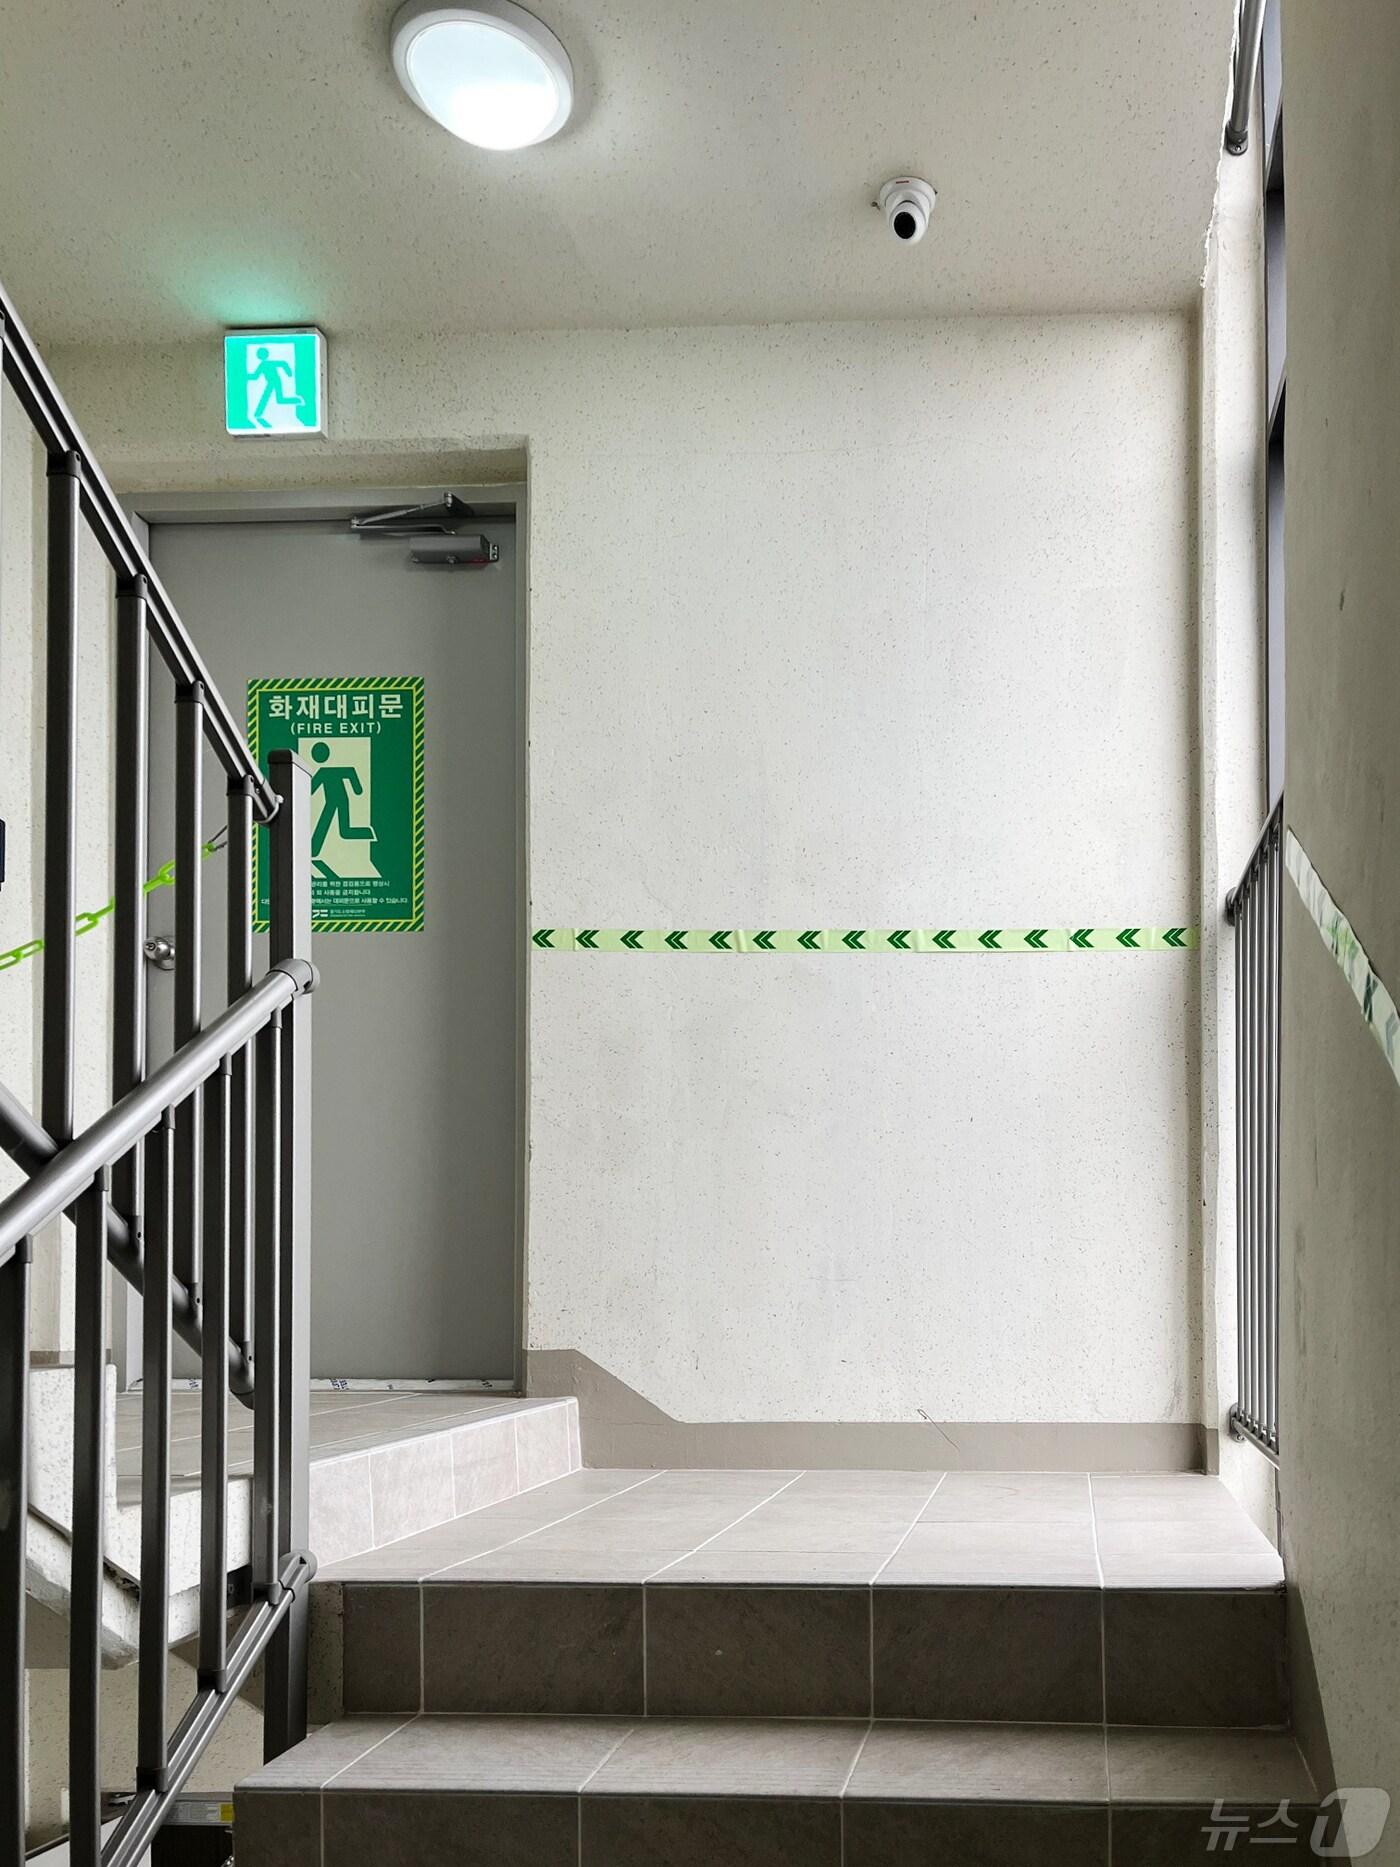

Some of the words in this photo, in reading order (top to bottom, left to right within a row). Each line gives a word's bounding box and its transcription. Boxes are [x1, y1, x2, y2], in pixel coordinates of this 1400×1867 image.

[268, 694, 404, 720] 화재대피문
[290, 722, 334, 735] (FIRE
[339, 721, 382, 734] EXIT)
